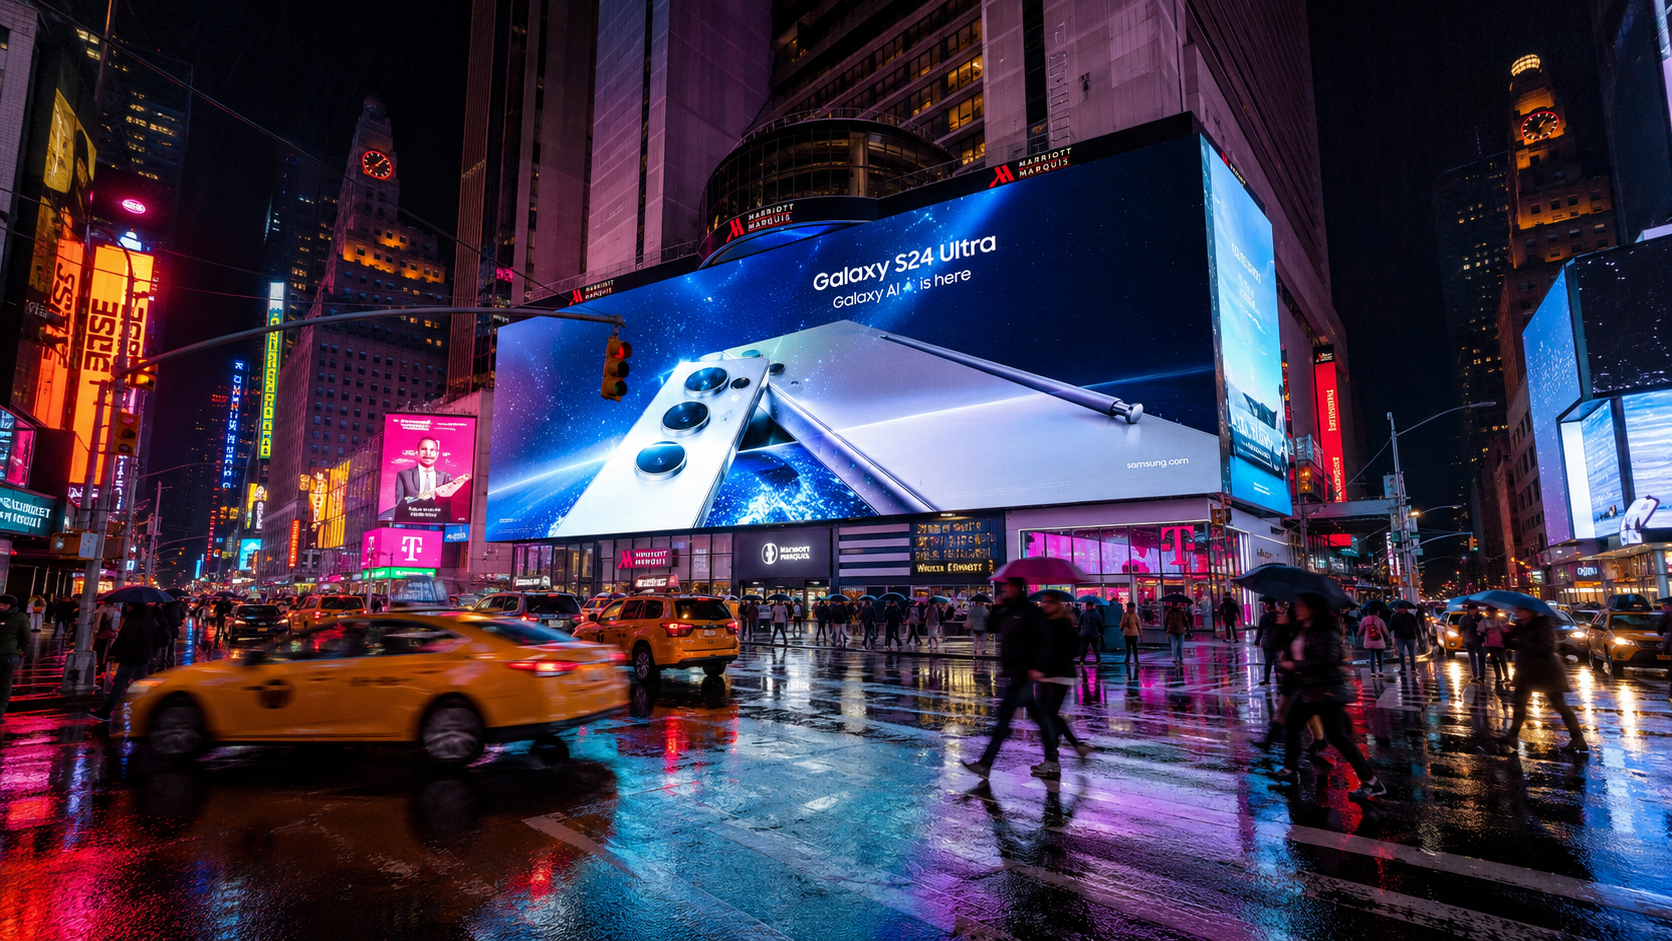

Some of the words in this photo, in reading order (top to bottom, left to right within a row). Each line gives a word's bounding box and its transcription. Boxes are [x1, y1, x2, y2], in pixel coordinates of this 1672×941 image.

[1019, 147, 1072, 167] MARRIOTT
[1019, 159, 1068, 177] MARQUIS
[813, 260, 890, 290] Galaxy
[894, 247, 934, 272] S24
[939, 235, 996, 262] Ultra
[833, 289, 884, 308] Galaxy
[886, 283, 900, 297] AI
[920, 277, 931, 289] is
[934, 269, 971, 287] here
[402, 535, 423, 561] T
